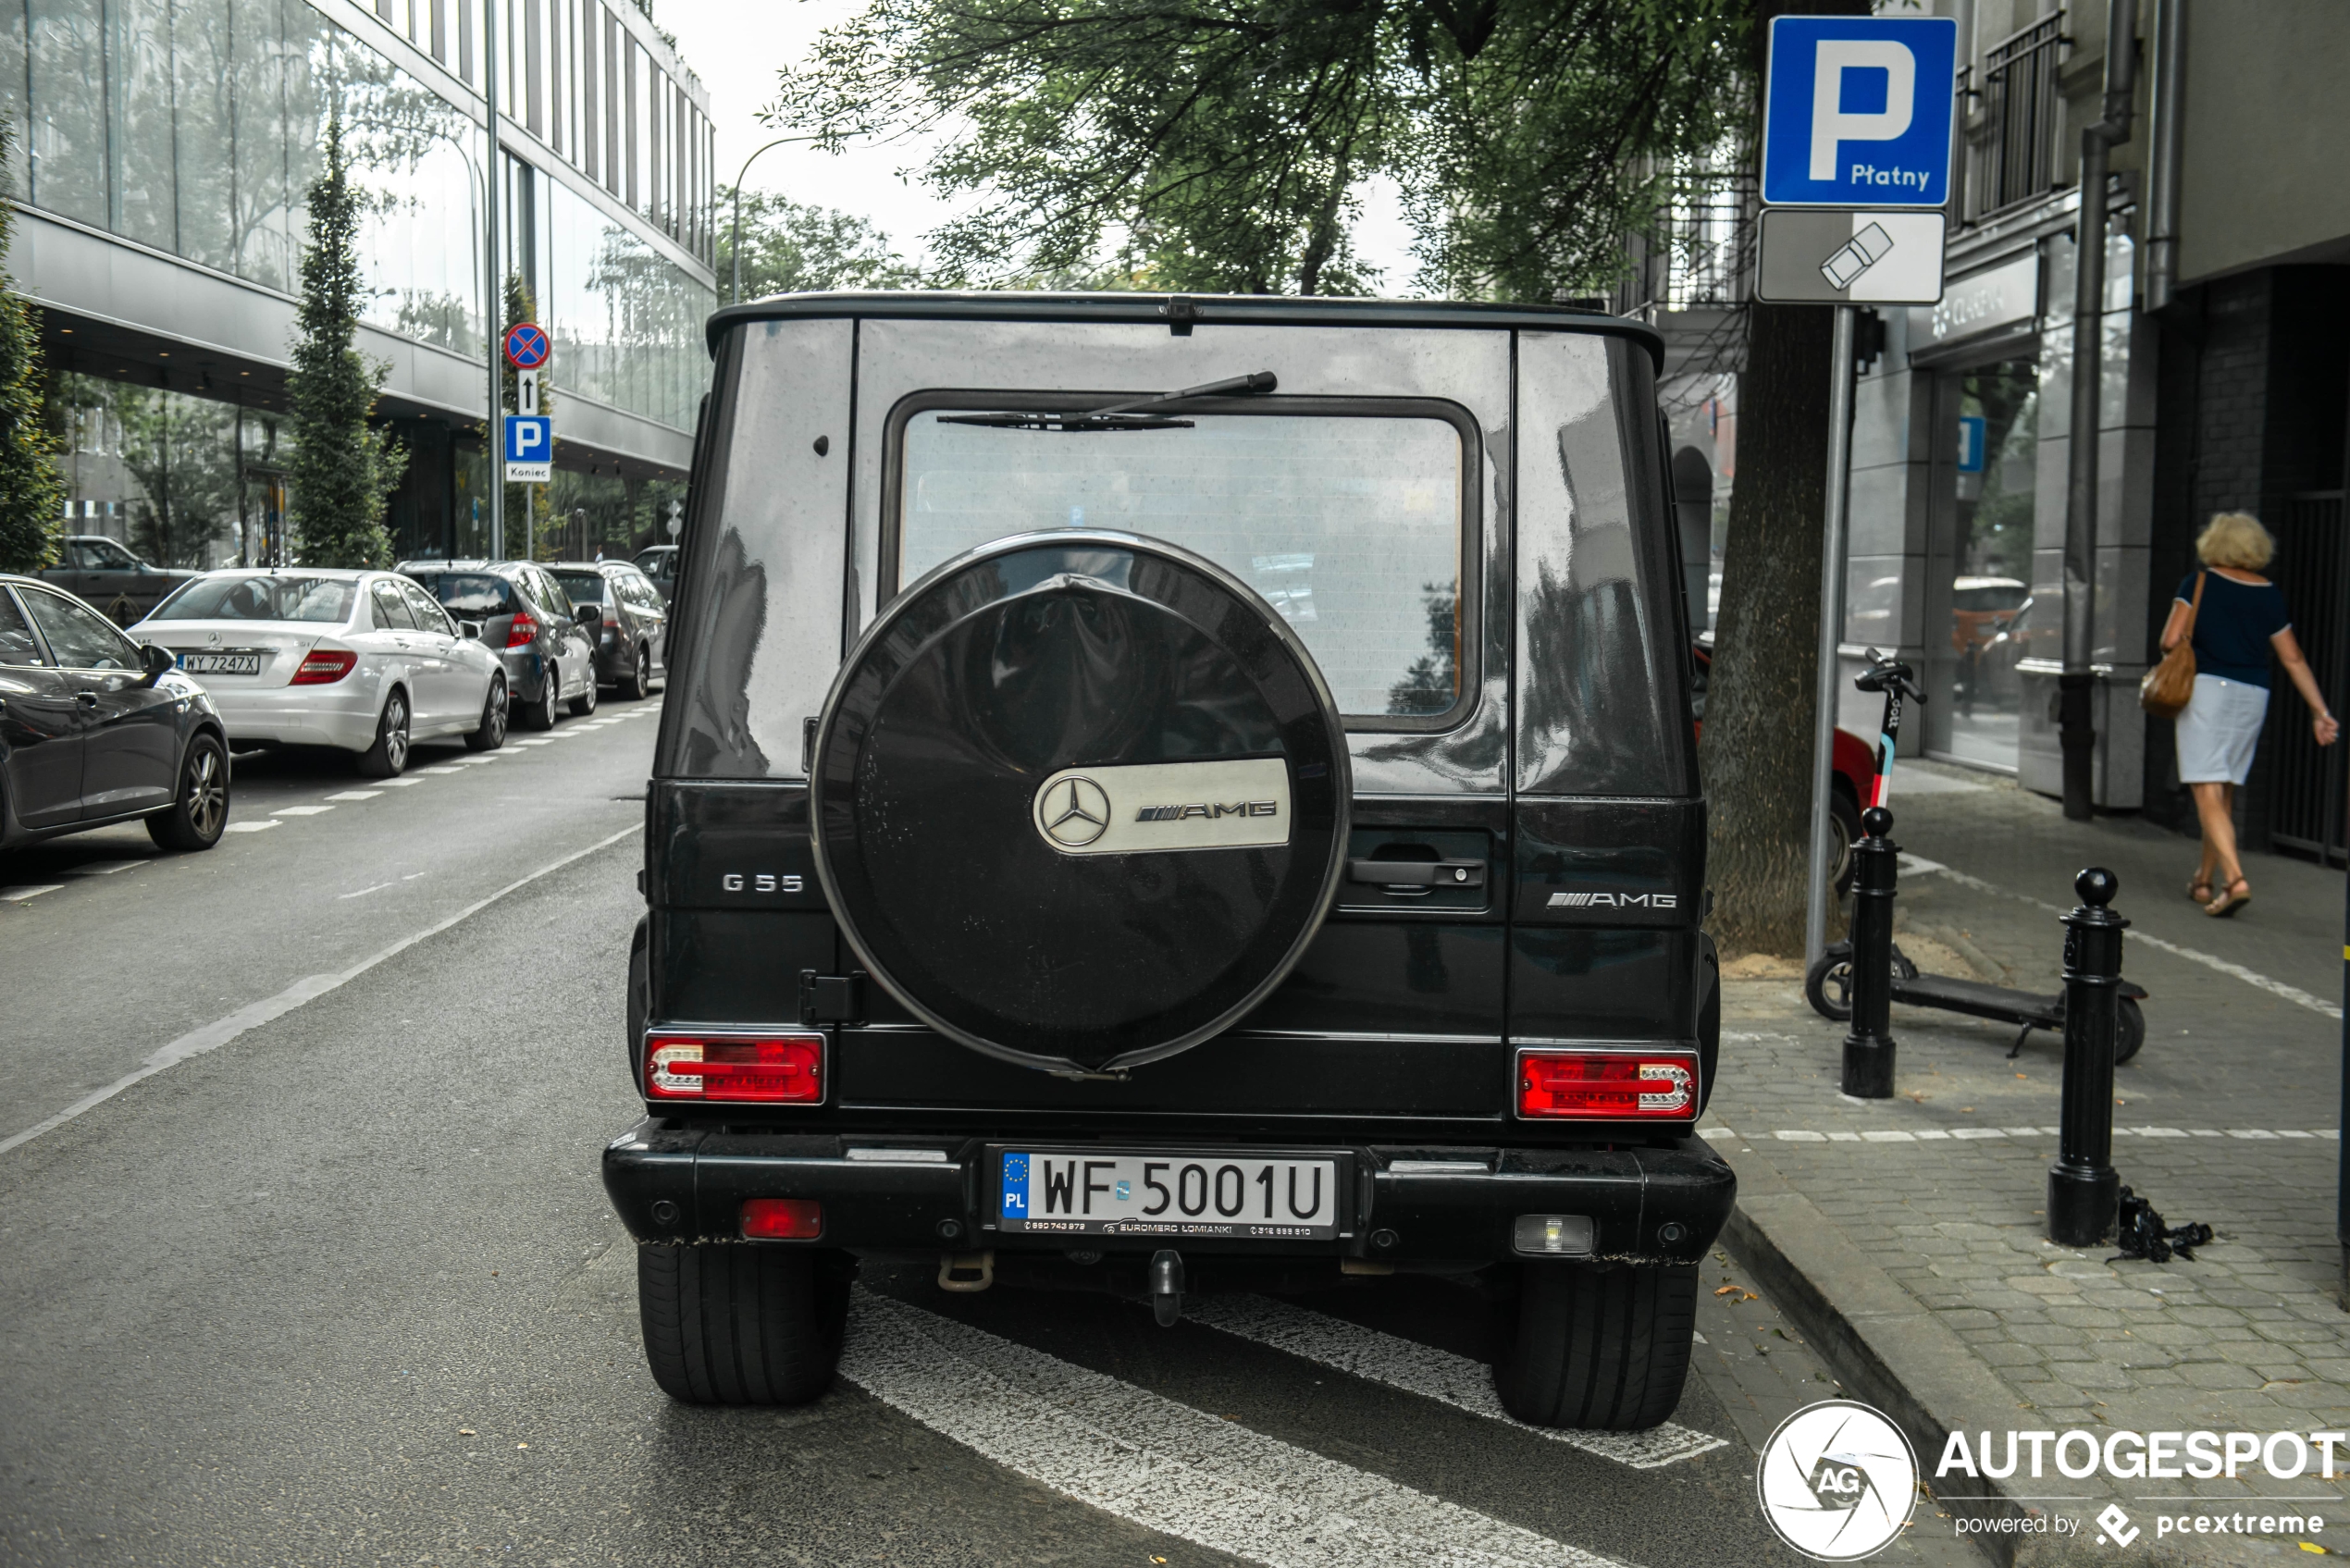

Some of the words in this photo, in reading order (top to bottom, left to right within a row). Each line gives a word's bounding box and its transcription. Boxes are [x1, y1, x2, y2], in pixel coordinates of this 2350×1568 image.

[1810, 40, 1916, 180] P
[1851, 164, 1930, 191] Płatny
[516, 421, 542, 457] P
[511, 467, 547, 476] Koniec
[187, 656, 204, 670] WY
[210, 657, 254, 670] 7247X
[1888, 698, 1901, 729] dott
[1180, 800, 1276, 820] AMG
[723, 874, 744, 892] G
[755, 874, 803, 893] 55
[1588, 893, 1677, 908] AMG
[1044, 1160, 1116, 1214] WF
[1141, 1162, 1321, 1218] 5001U
[1006, 1193, 1025, 1208] PL
[1119, 1223, 1178, 1233] EUROMERC
[1181, 1225, 1232, 1234] ŁOMIANKI
